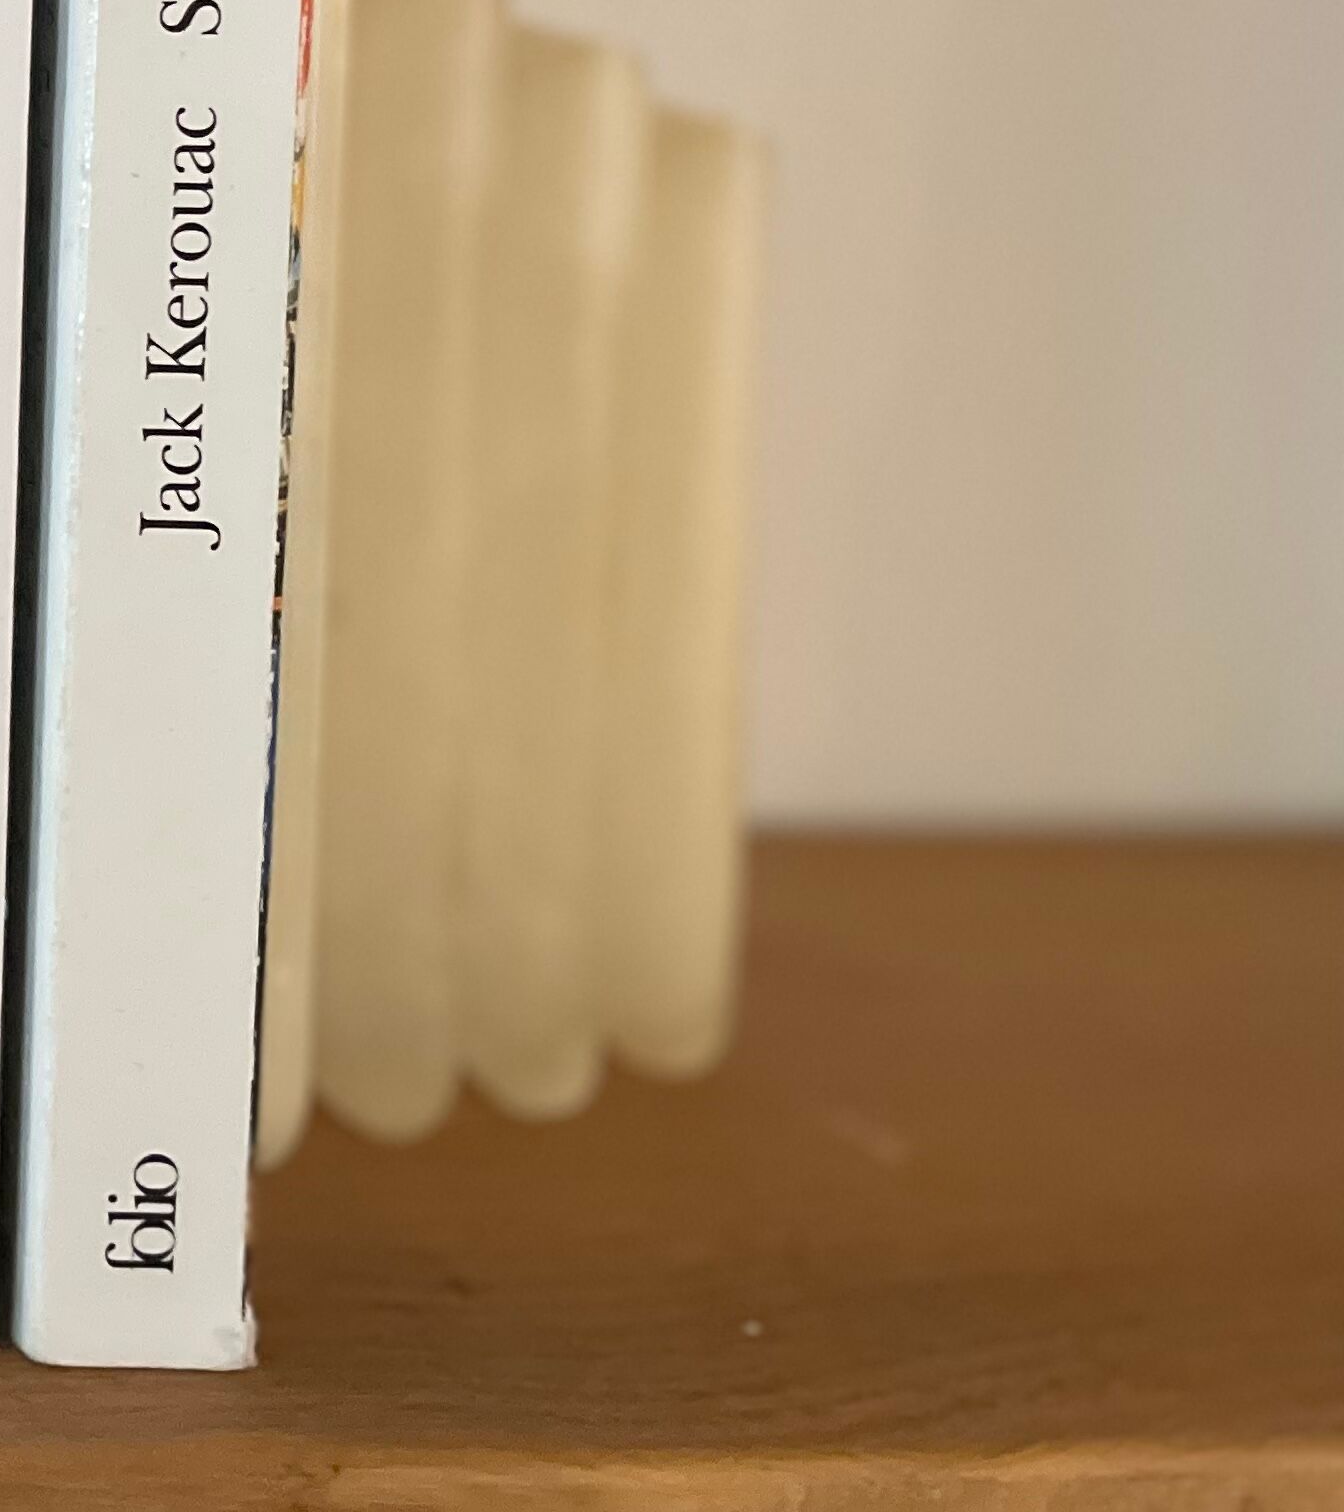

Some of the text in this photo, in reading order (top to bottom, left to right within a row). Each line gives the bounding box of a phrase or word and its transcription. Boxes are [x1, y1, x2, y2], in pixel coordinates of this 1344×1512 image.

[137, 106, 223, 553] Jack Kerouac
[103, 1152, 180, 1275] folio
